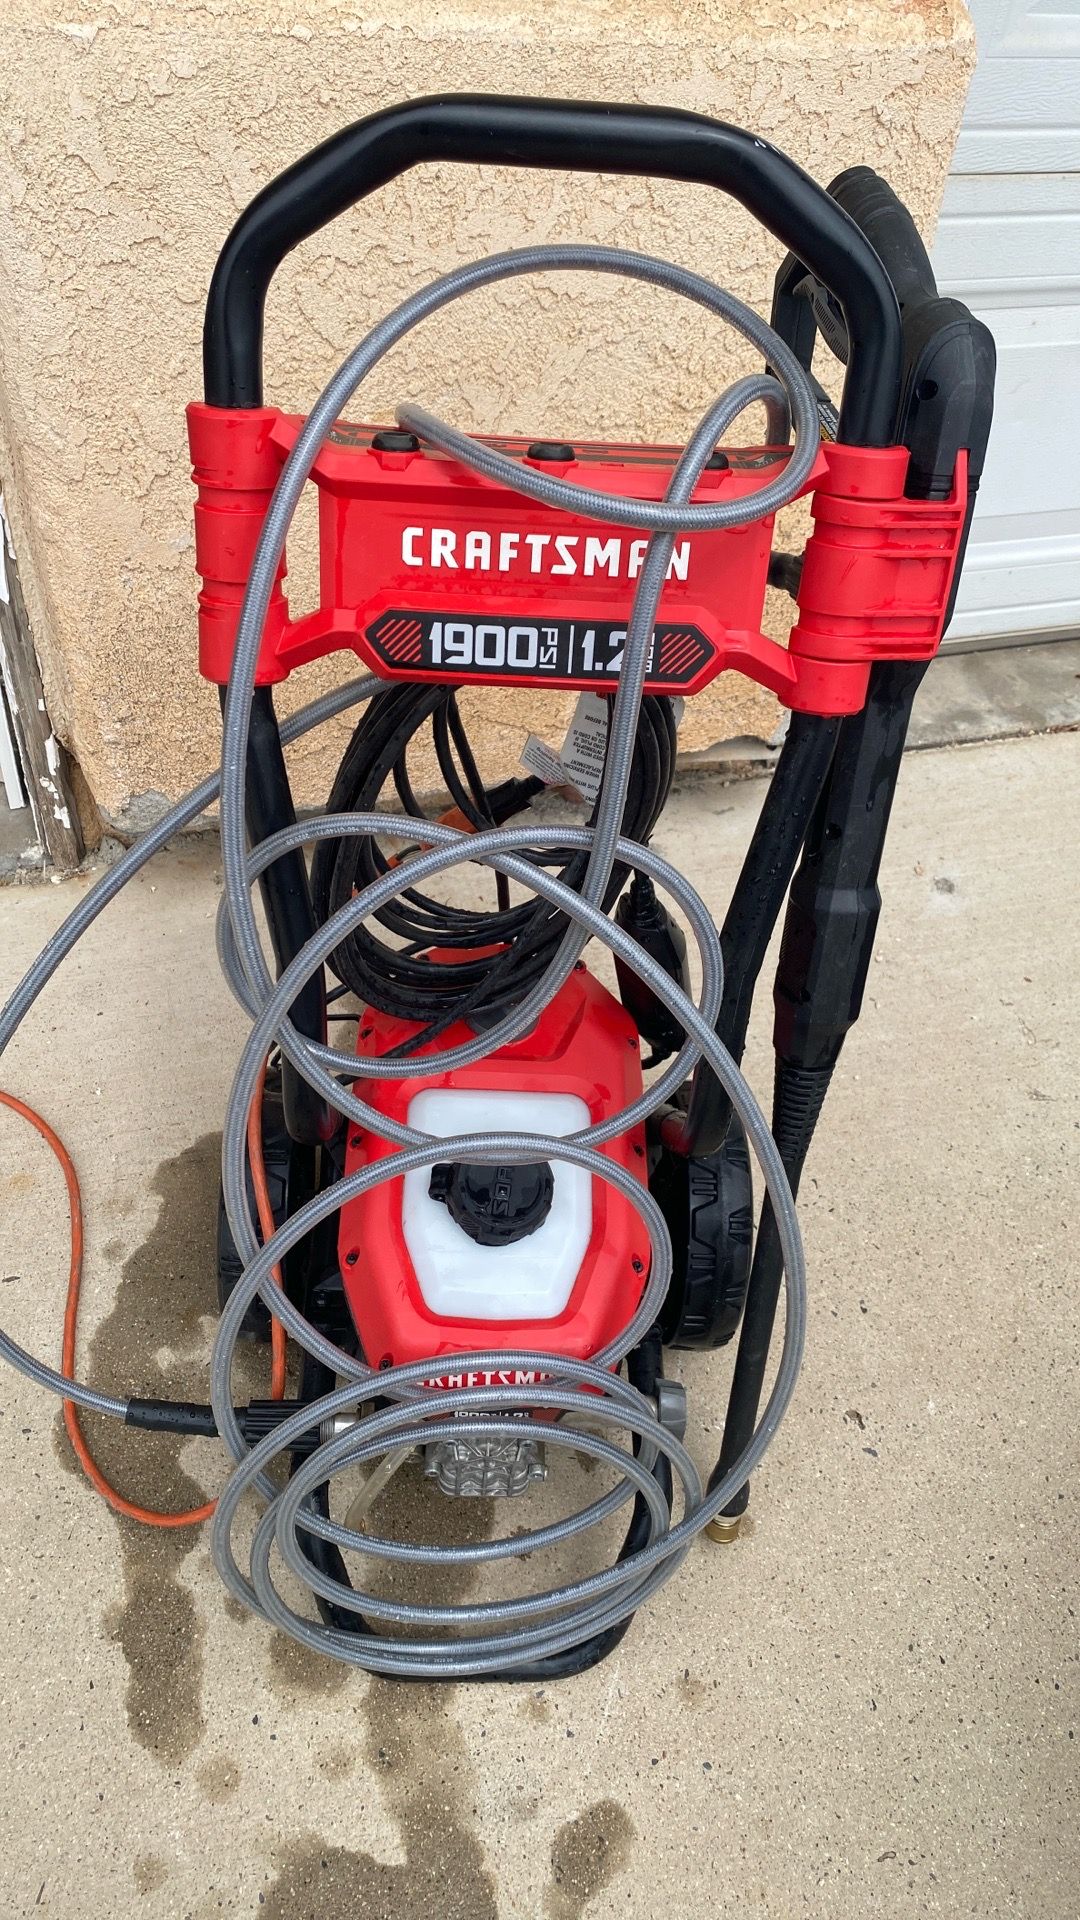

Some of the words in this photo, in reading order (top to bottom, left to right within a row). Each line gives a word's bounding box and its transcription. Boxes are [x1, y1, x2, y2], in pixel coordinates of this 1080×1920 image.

[401, 526, 690, 581] CRAFTSMAN
[429, 621, 538, 668] 1900
[539, 627, 558, 669] PSI
[581, 629, 627, 671] 1.2
